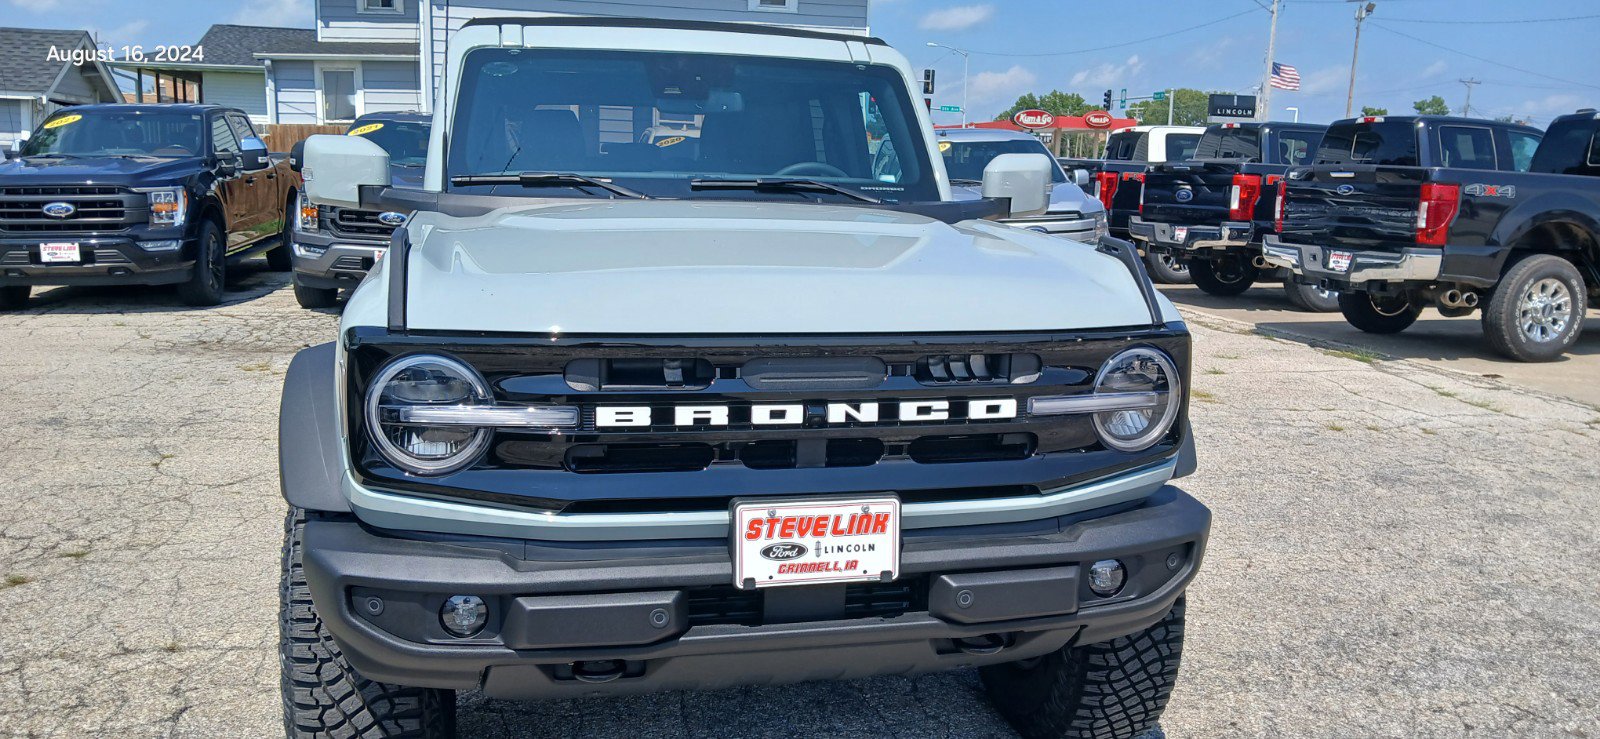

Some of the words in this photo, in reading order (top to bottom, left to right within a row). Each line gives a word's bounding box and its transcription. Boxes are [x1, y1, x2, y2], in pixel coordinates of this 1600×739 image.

[658, 136, 682, 147] 2020
[595, 399, 1017, 427] BRONCO
[745, 514, 831, 541] STEVE
[831, 512, 891, 537] LINK
[768, 545, 799, 559] Ford
[824, 543, 876, 553] LINCOLN
[777, 561, 843, 574] GRINNELL,
[844, 559, 859, 571] IA
